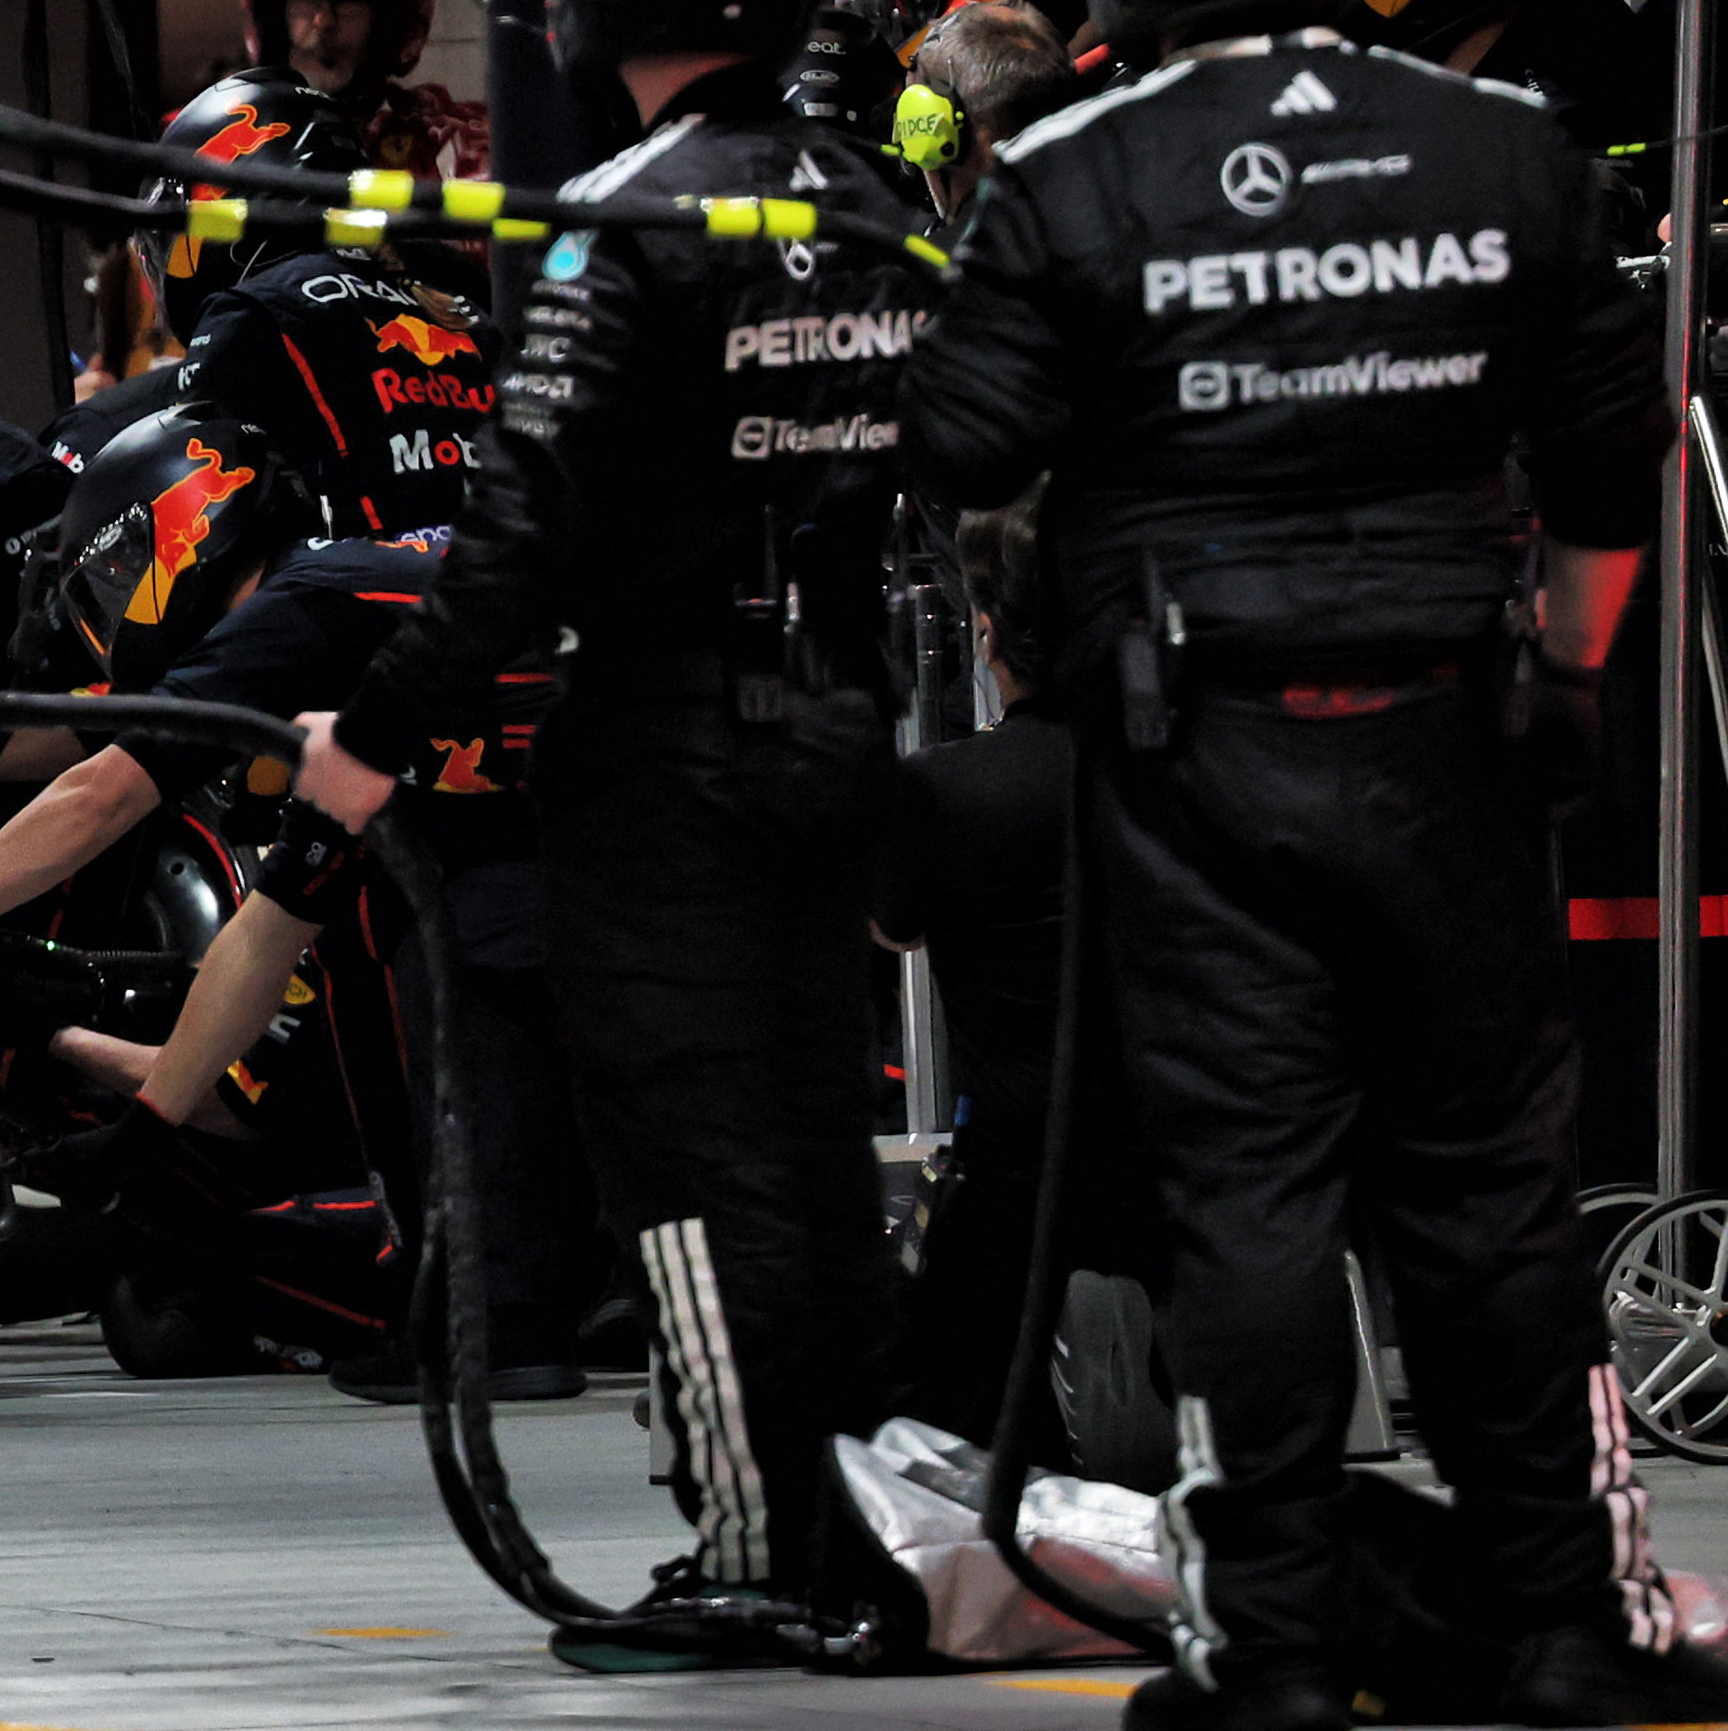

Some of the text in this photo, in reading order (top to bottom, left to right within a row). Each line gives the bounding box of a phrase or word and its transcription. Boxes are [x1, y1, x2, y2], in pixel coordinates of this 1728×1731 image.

[1144, 227, 1511, 316] PETRONAS
[725, 309, 926, 372] PETRONA
[1230, 348, 1489, 405] TeamViewer
